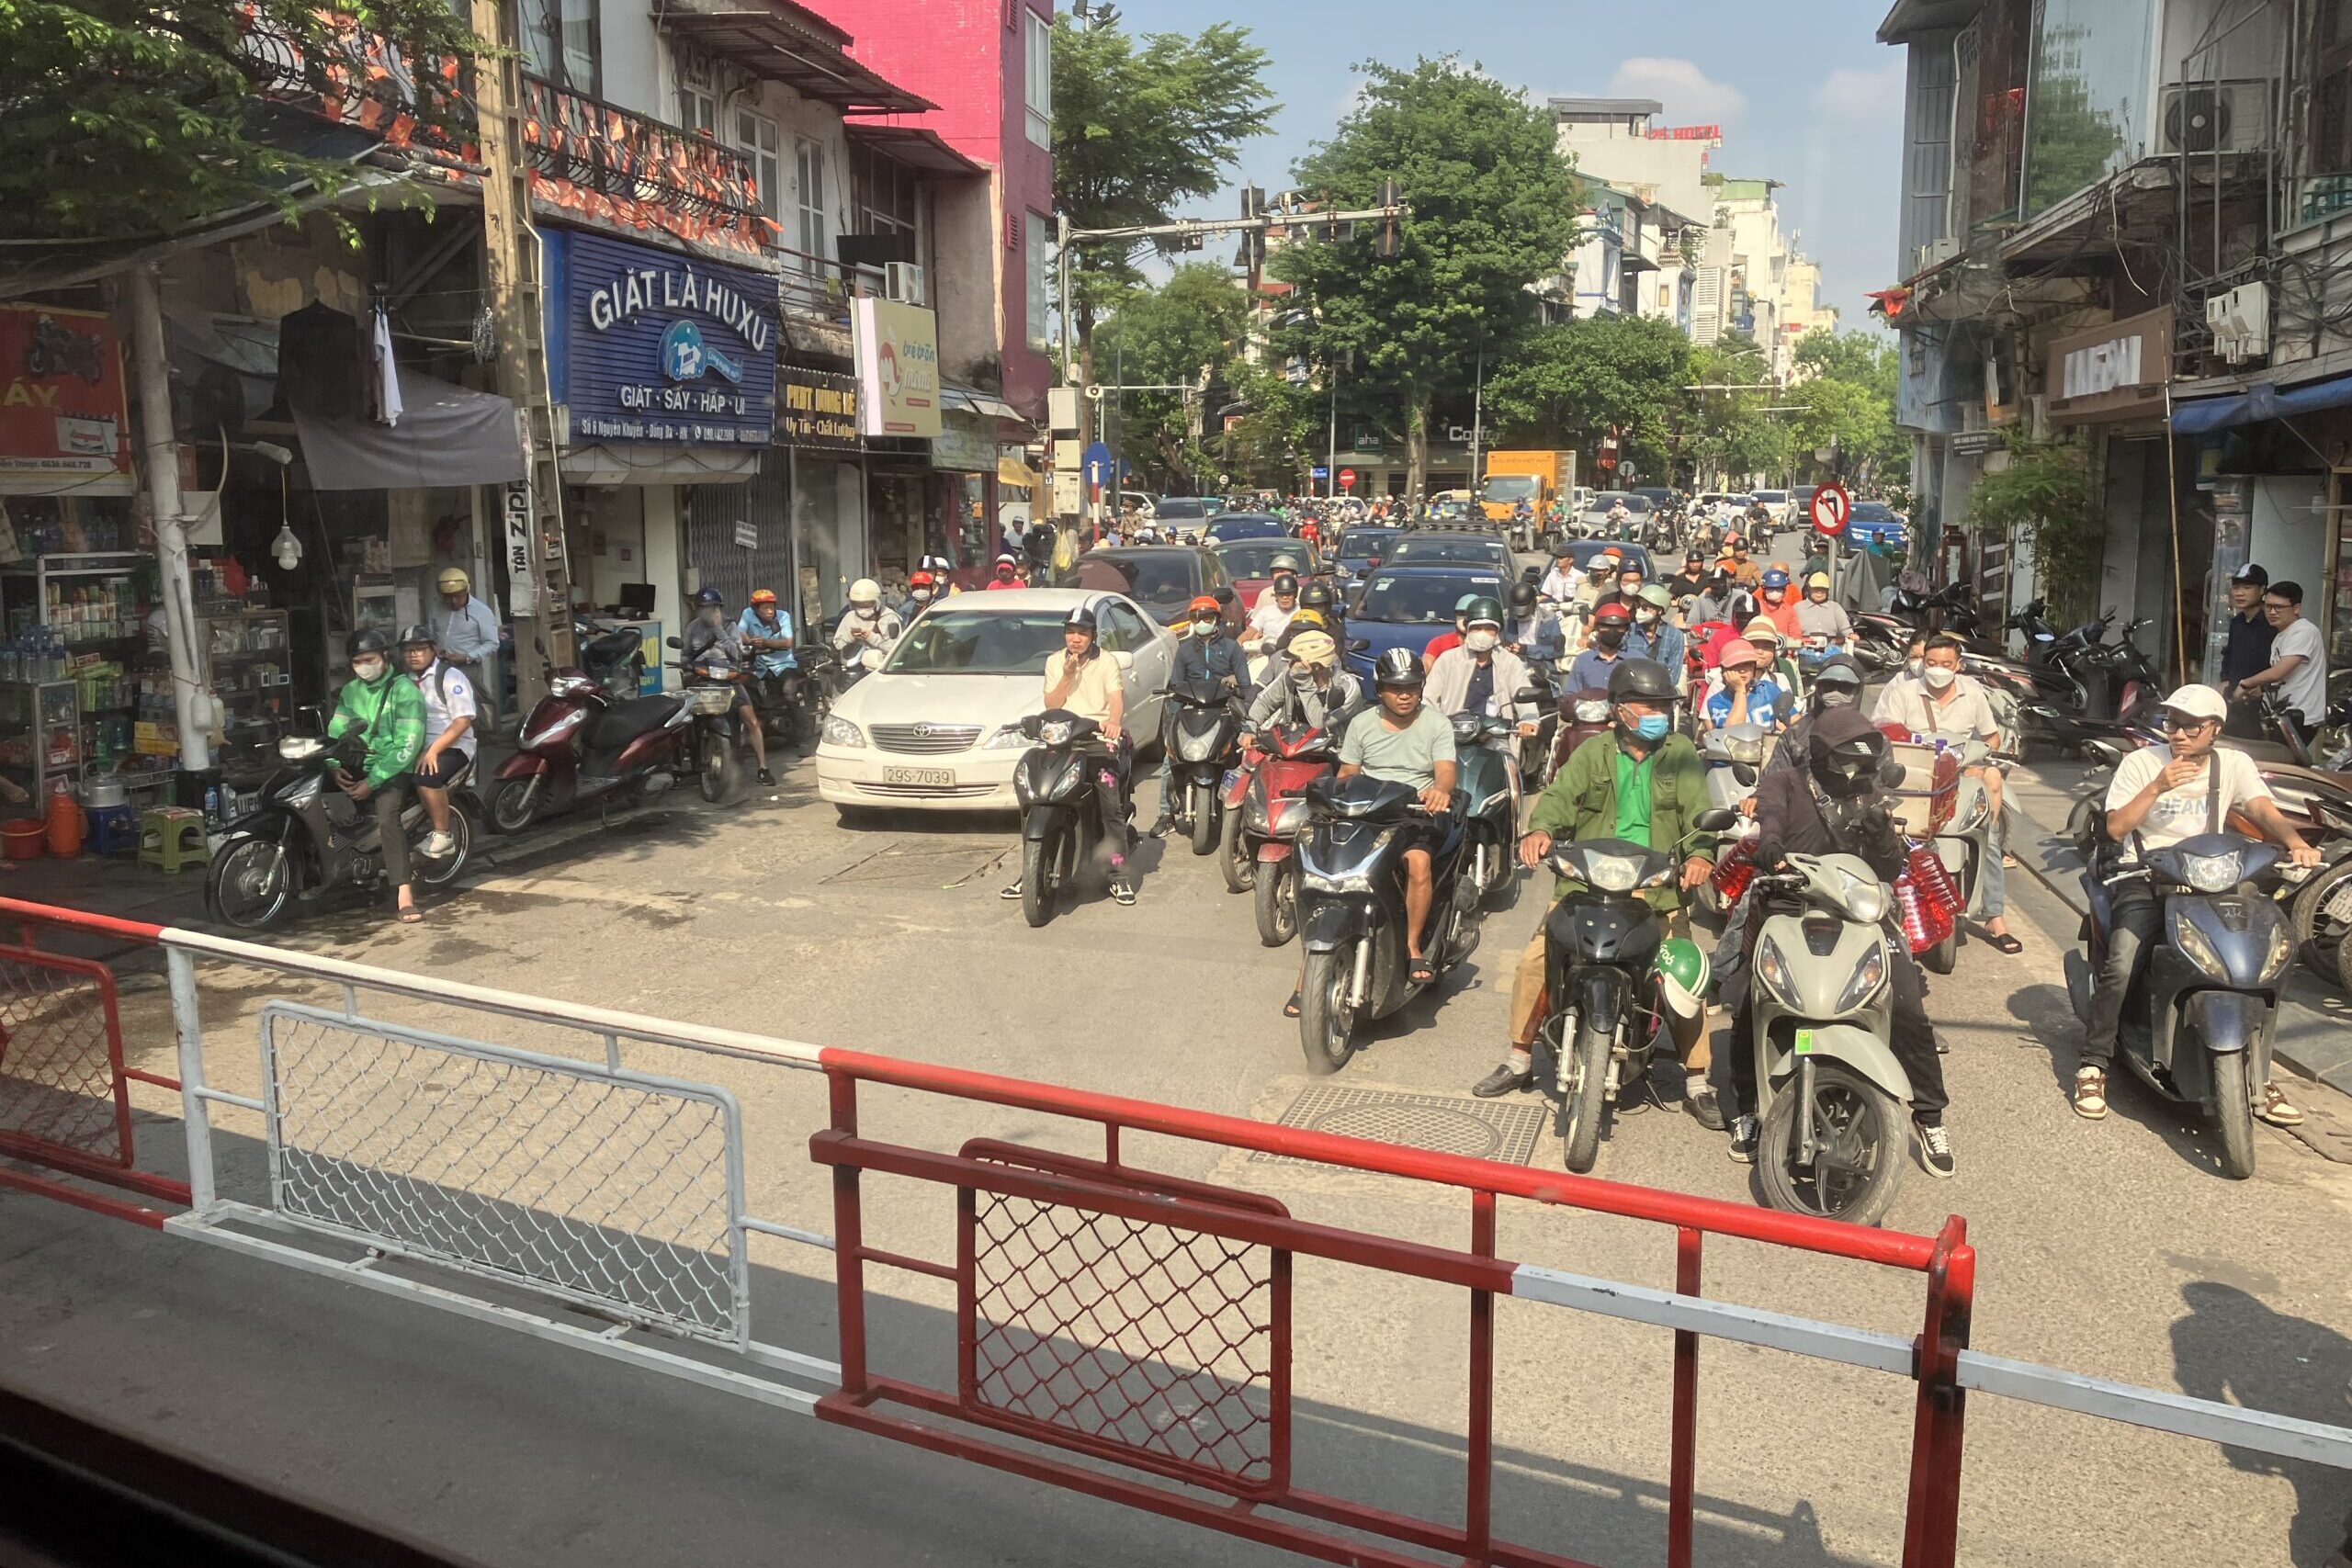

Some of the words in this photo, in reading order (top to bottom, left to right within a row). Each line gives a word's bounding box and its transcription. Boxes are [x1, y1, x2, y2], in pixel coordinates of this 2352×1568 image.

[591, 267, 656, 330] GIẶT
[664, 265, 698, 309] LÀ
[705, 278, 767, 352] HUXU
[620, 384, 652, 412] GIẶT
[664, 386, 690, 411] SẤY
[700, 387, 726, 413] HẤP
[1358, 434, 1379, 446] aha
[512, 546, 527, 574] TÂN
[887, 768, 951, 784] 29S-7039
